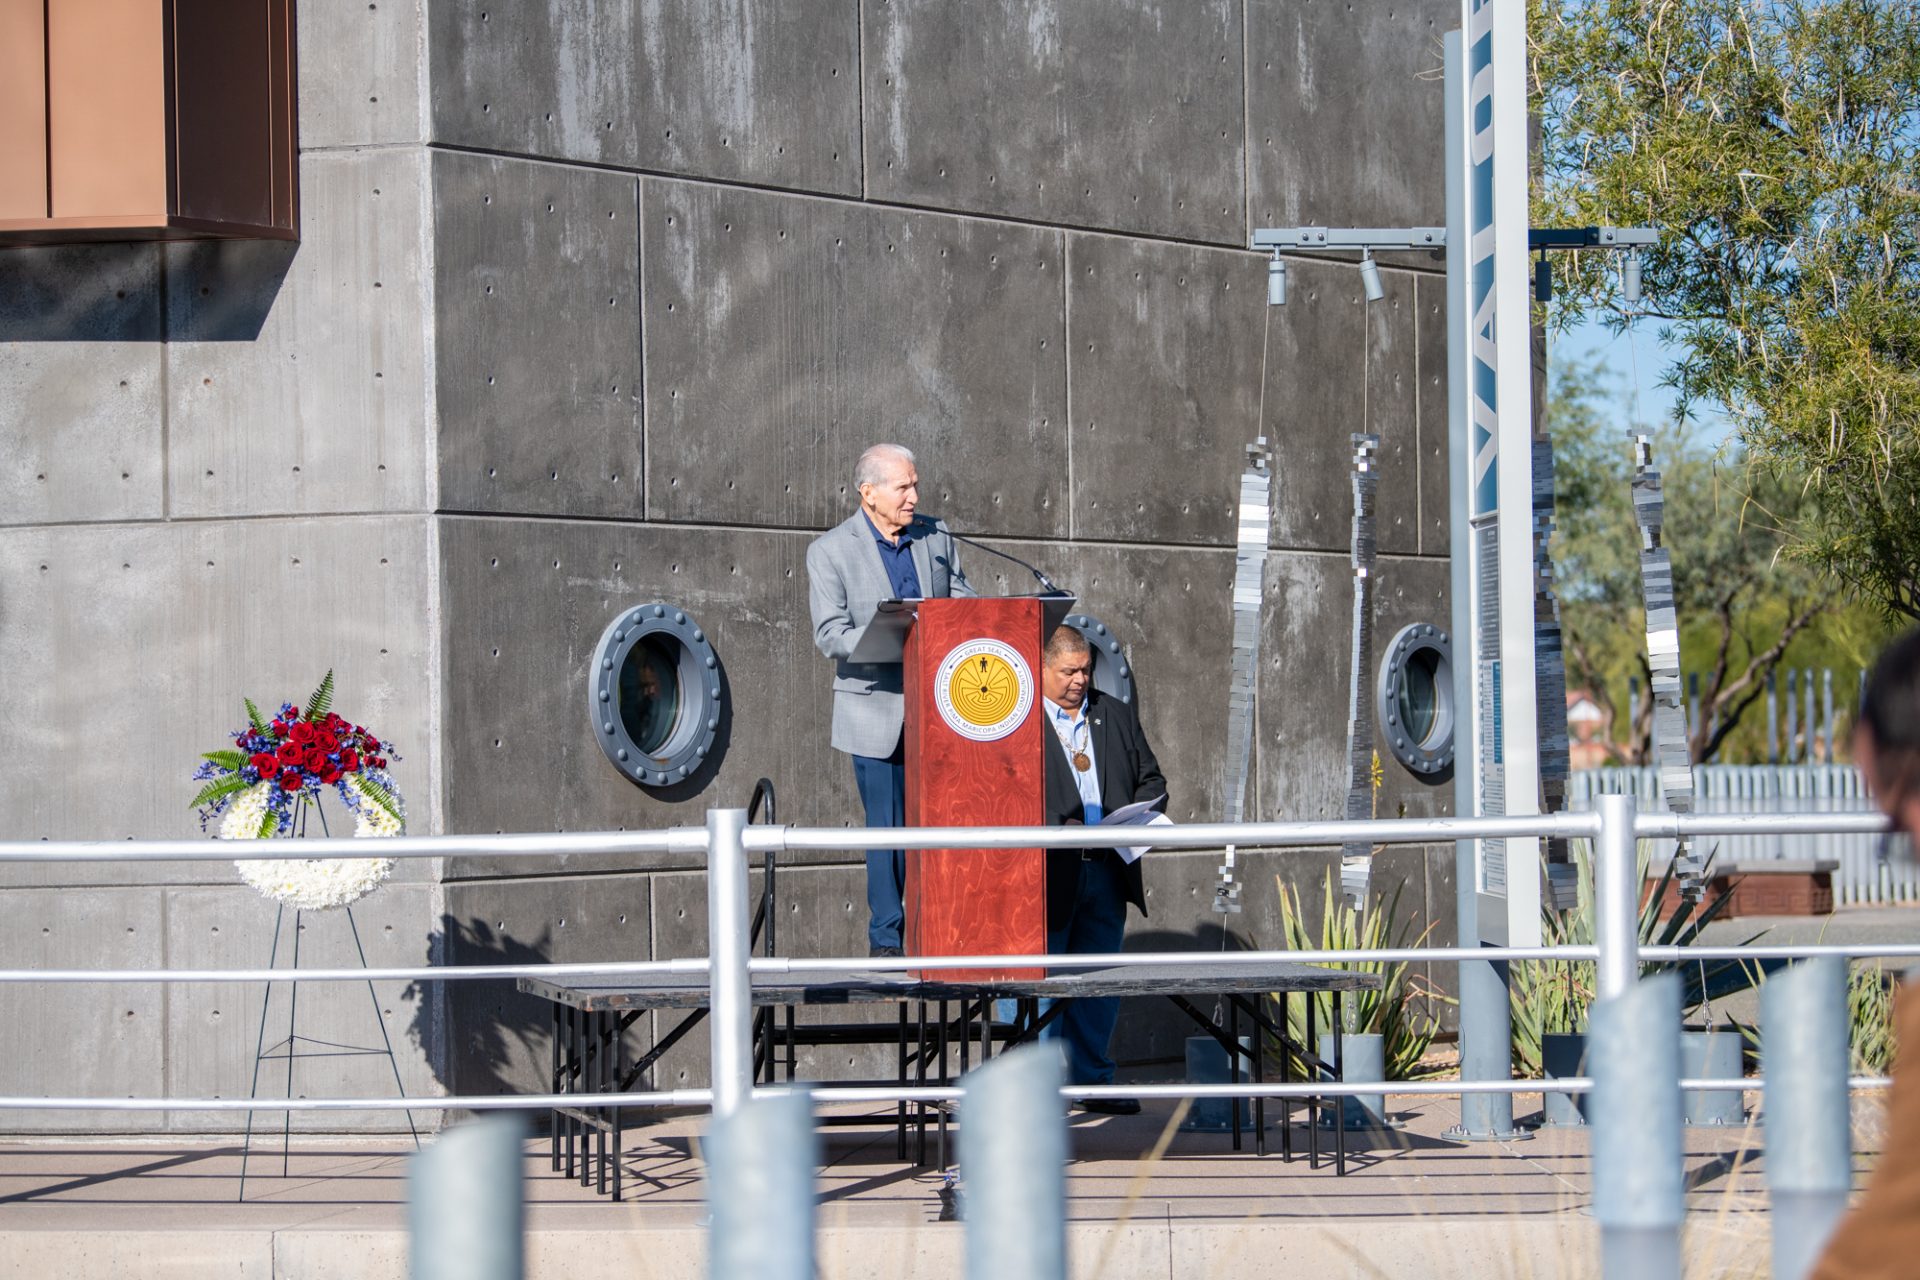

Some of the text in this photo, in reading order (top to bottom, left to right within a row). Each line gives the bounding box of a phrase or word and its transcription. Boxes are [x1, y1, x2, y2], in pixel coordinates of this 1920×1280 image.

[964, 646, 1003, 656] GREAT SEAL
[942, 672, 951, 686] SALT
[942, 687, 951, 707] RIVER
[1017, 670, 1027, 712] COMMUNITY
[997, 713, 1019, 730] INDIAN
